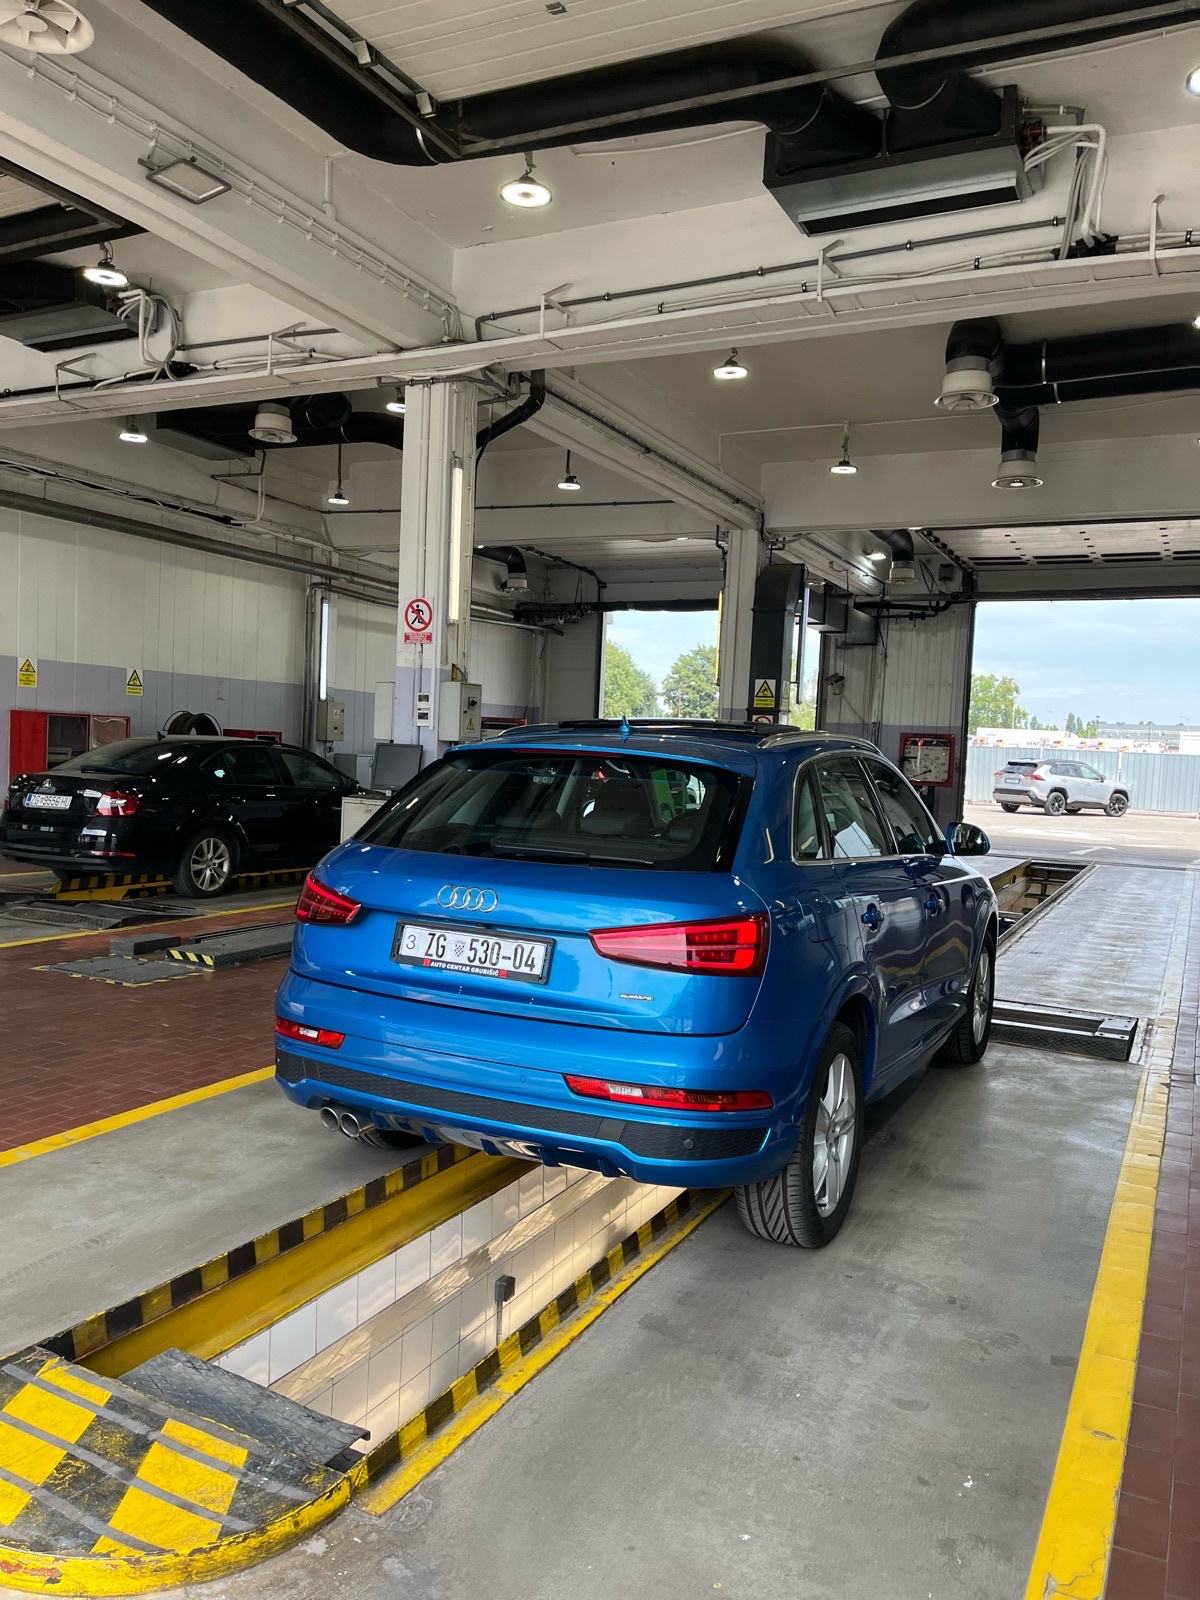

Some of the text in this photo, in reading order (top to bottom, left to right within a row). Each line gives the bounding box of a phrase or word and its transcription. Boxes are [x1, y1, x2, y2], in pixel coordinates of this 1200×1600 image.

[31, 795, 40, 805] ZG
[405, 932, 536, 972] 3 ZG 530-04
[430, 961, 446, 969] AUTO
[447, 963, 470, 973] CENTAR
